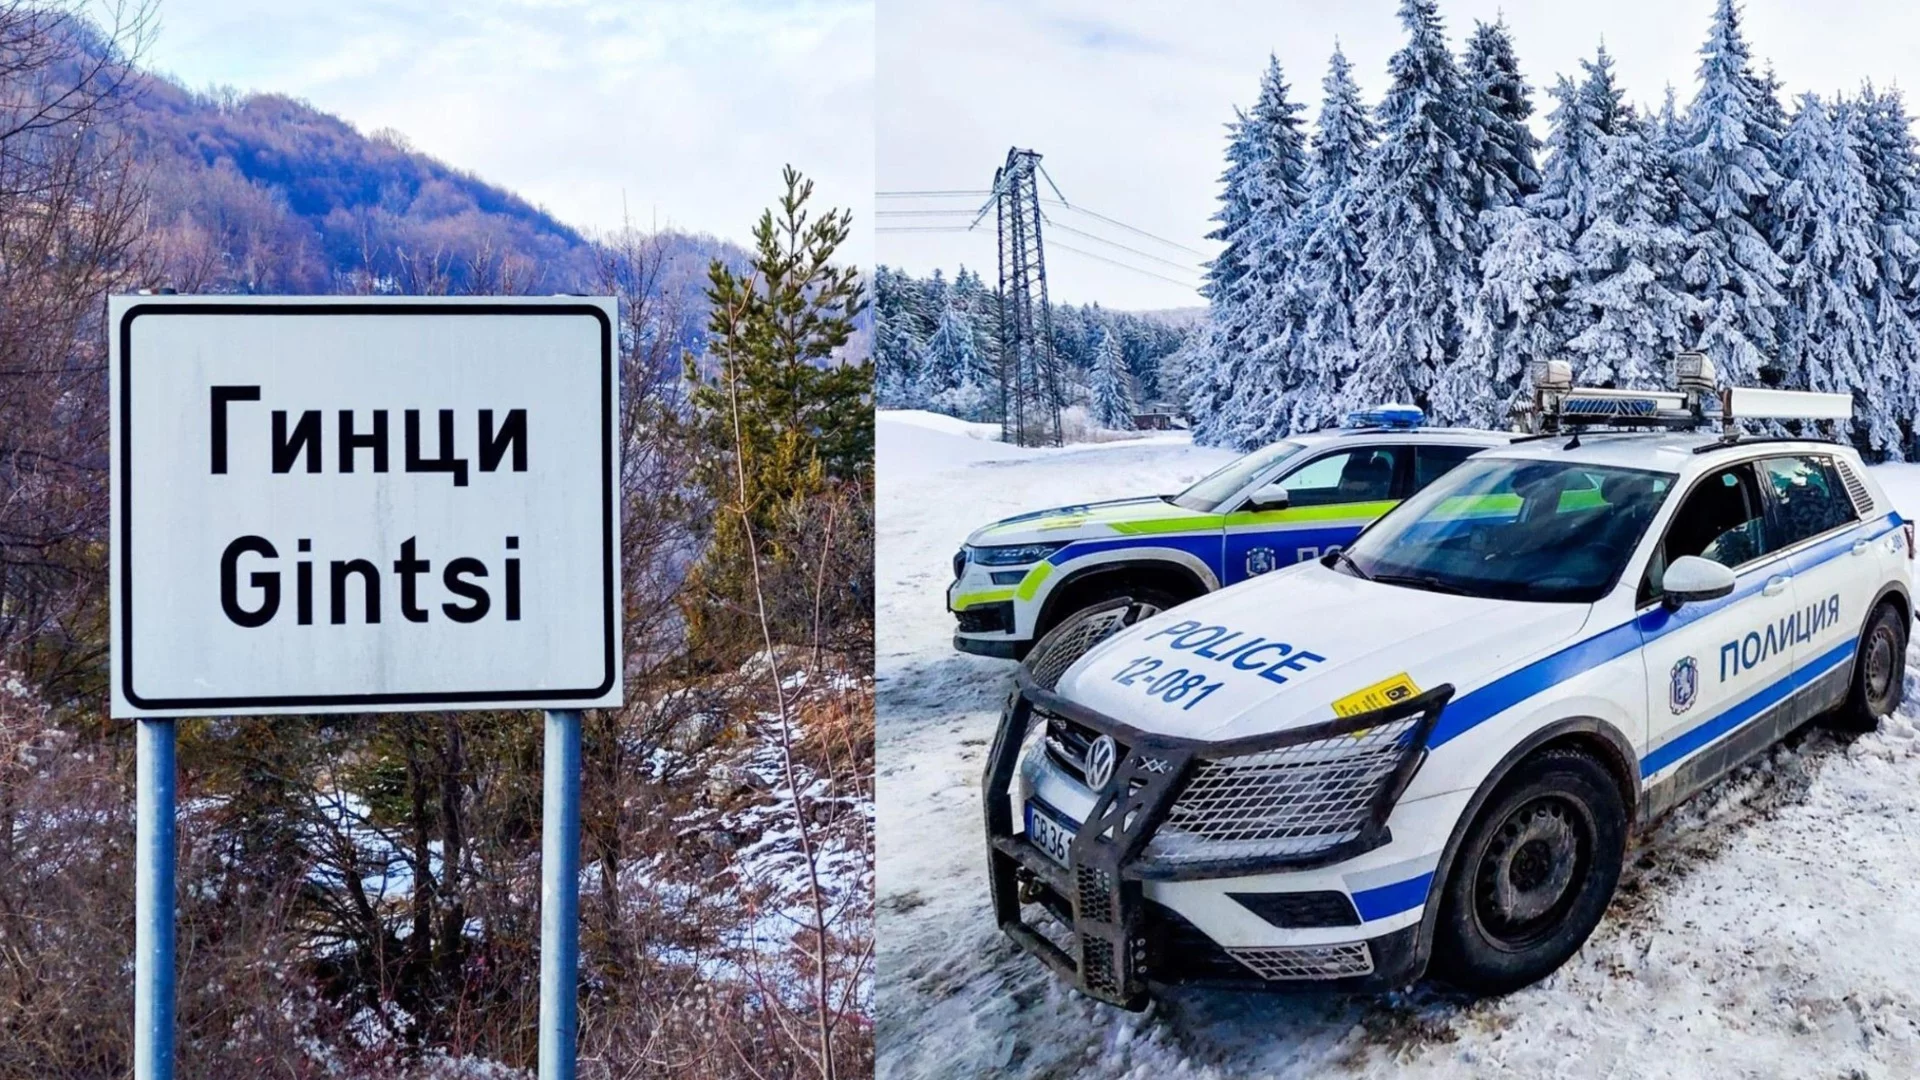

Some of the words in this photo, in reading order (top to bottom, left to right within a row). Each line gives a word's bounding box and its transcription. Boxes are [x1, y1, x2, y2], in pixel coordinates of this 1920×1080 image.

[210, 385, 528, 487] Гинци
[220, 534, 521, 628] Gintsi
[1143, 620, 1326, 684] POLICE
[1719, 592, 1840, 683] ПОЛИЦИЯ
[1111, 656, 1225, 710] 12-081
[1049, 826, 1072, 860] 36
